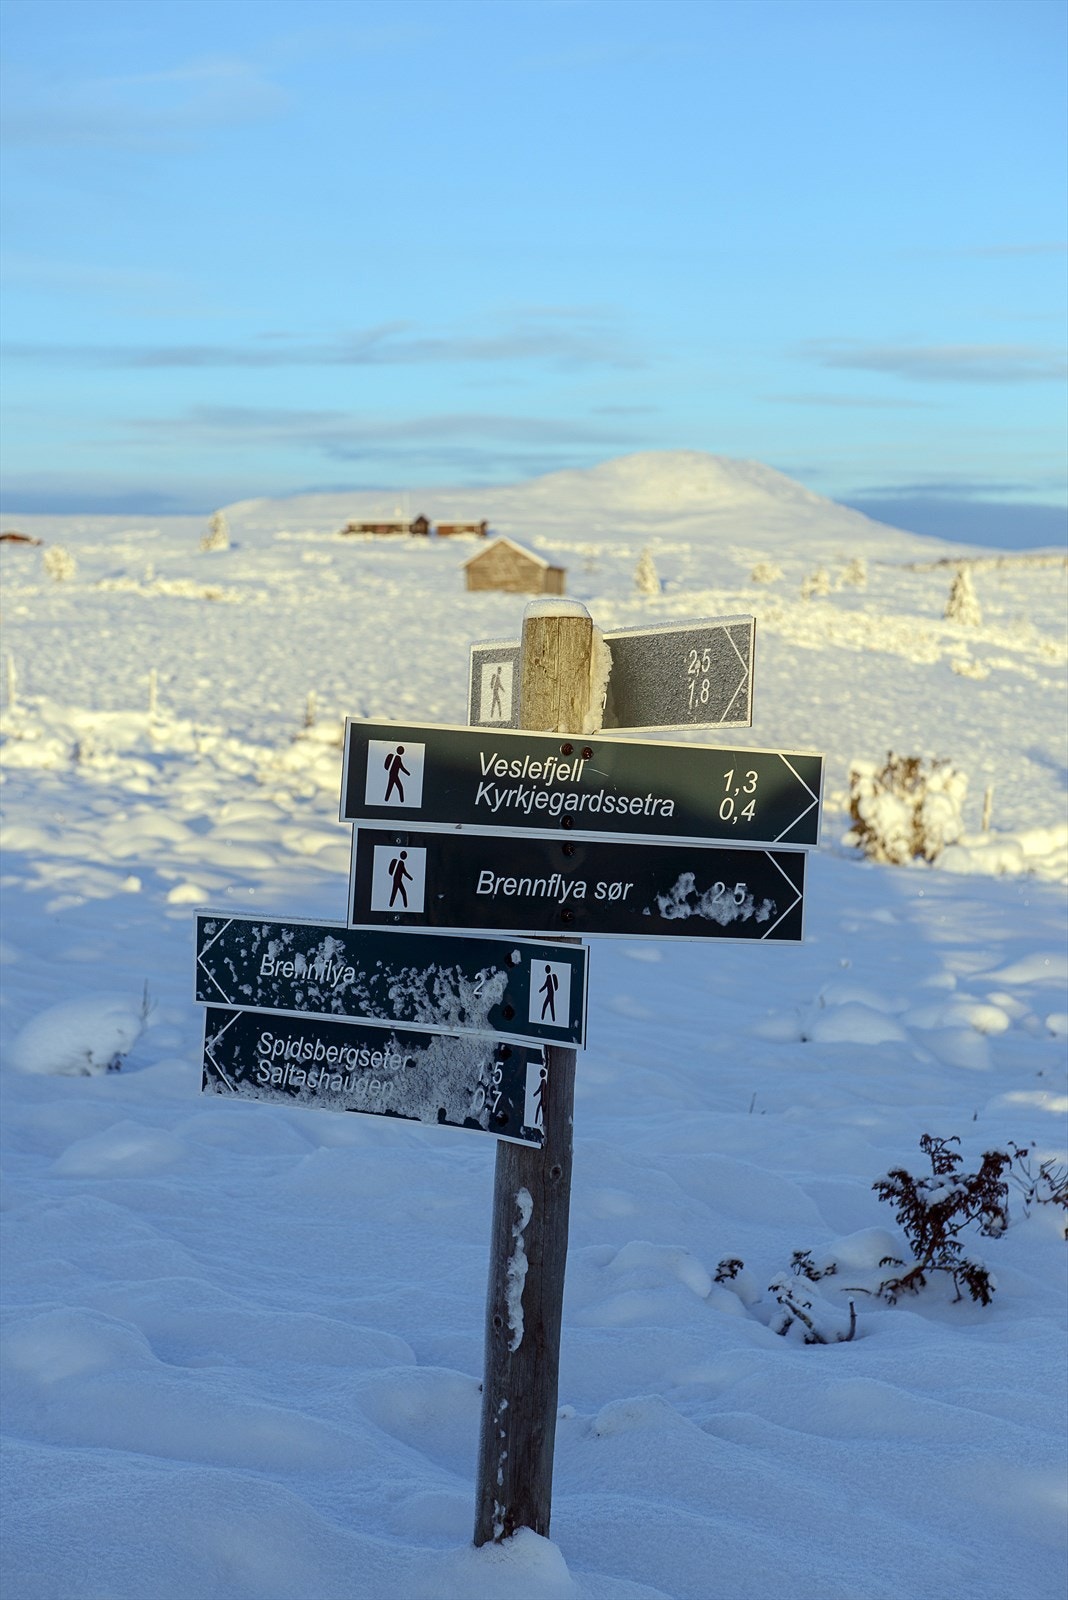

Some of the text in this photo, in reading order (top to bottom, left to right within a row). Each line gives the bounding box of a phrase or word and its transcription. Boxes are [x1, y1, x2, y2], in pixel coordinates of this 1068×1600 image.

[478, 752, 759, 796] Veslefjell 1,3
[474, 781, 756, 825] Kyrkjegardssetra 0,4
[475, 870, 587, 904] Brennflya
[594, 881, 634, 901] sør
[258, 1031, 412, 1073] Spidsbergseter
